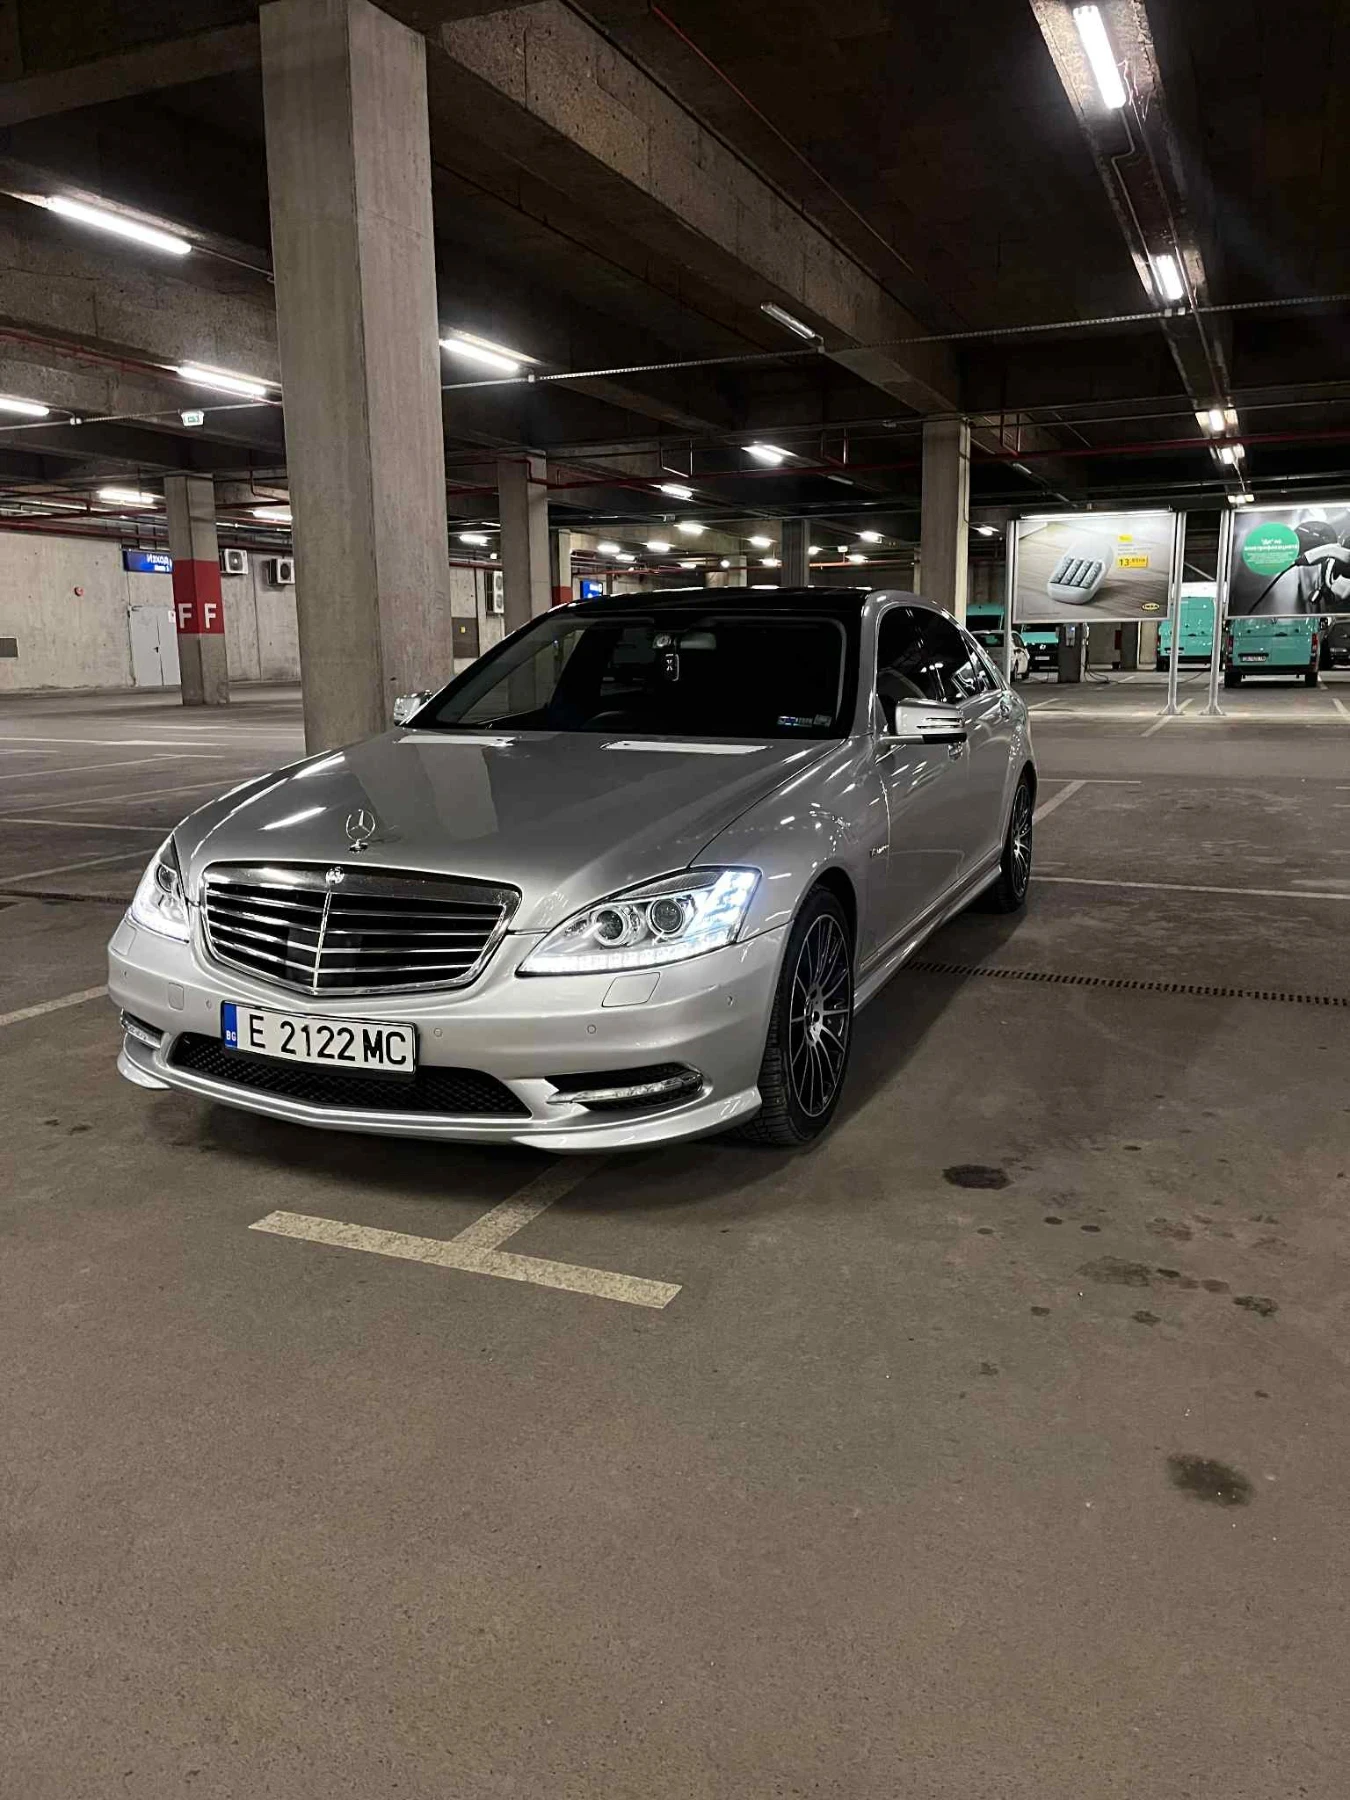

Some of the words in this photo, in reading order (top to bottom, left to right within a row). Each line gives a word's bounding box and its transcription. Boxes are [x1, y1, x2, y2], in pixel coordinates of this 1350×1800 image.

[178, 603, 192, 629] F
[204, 603, 217, 629] F
[225, 1029, 237, 1042] BG
[249, 1013, 266, 1049] E
[279, 1020, 356, 1062] 2122
[362, 1028, 407, 1066] MC
